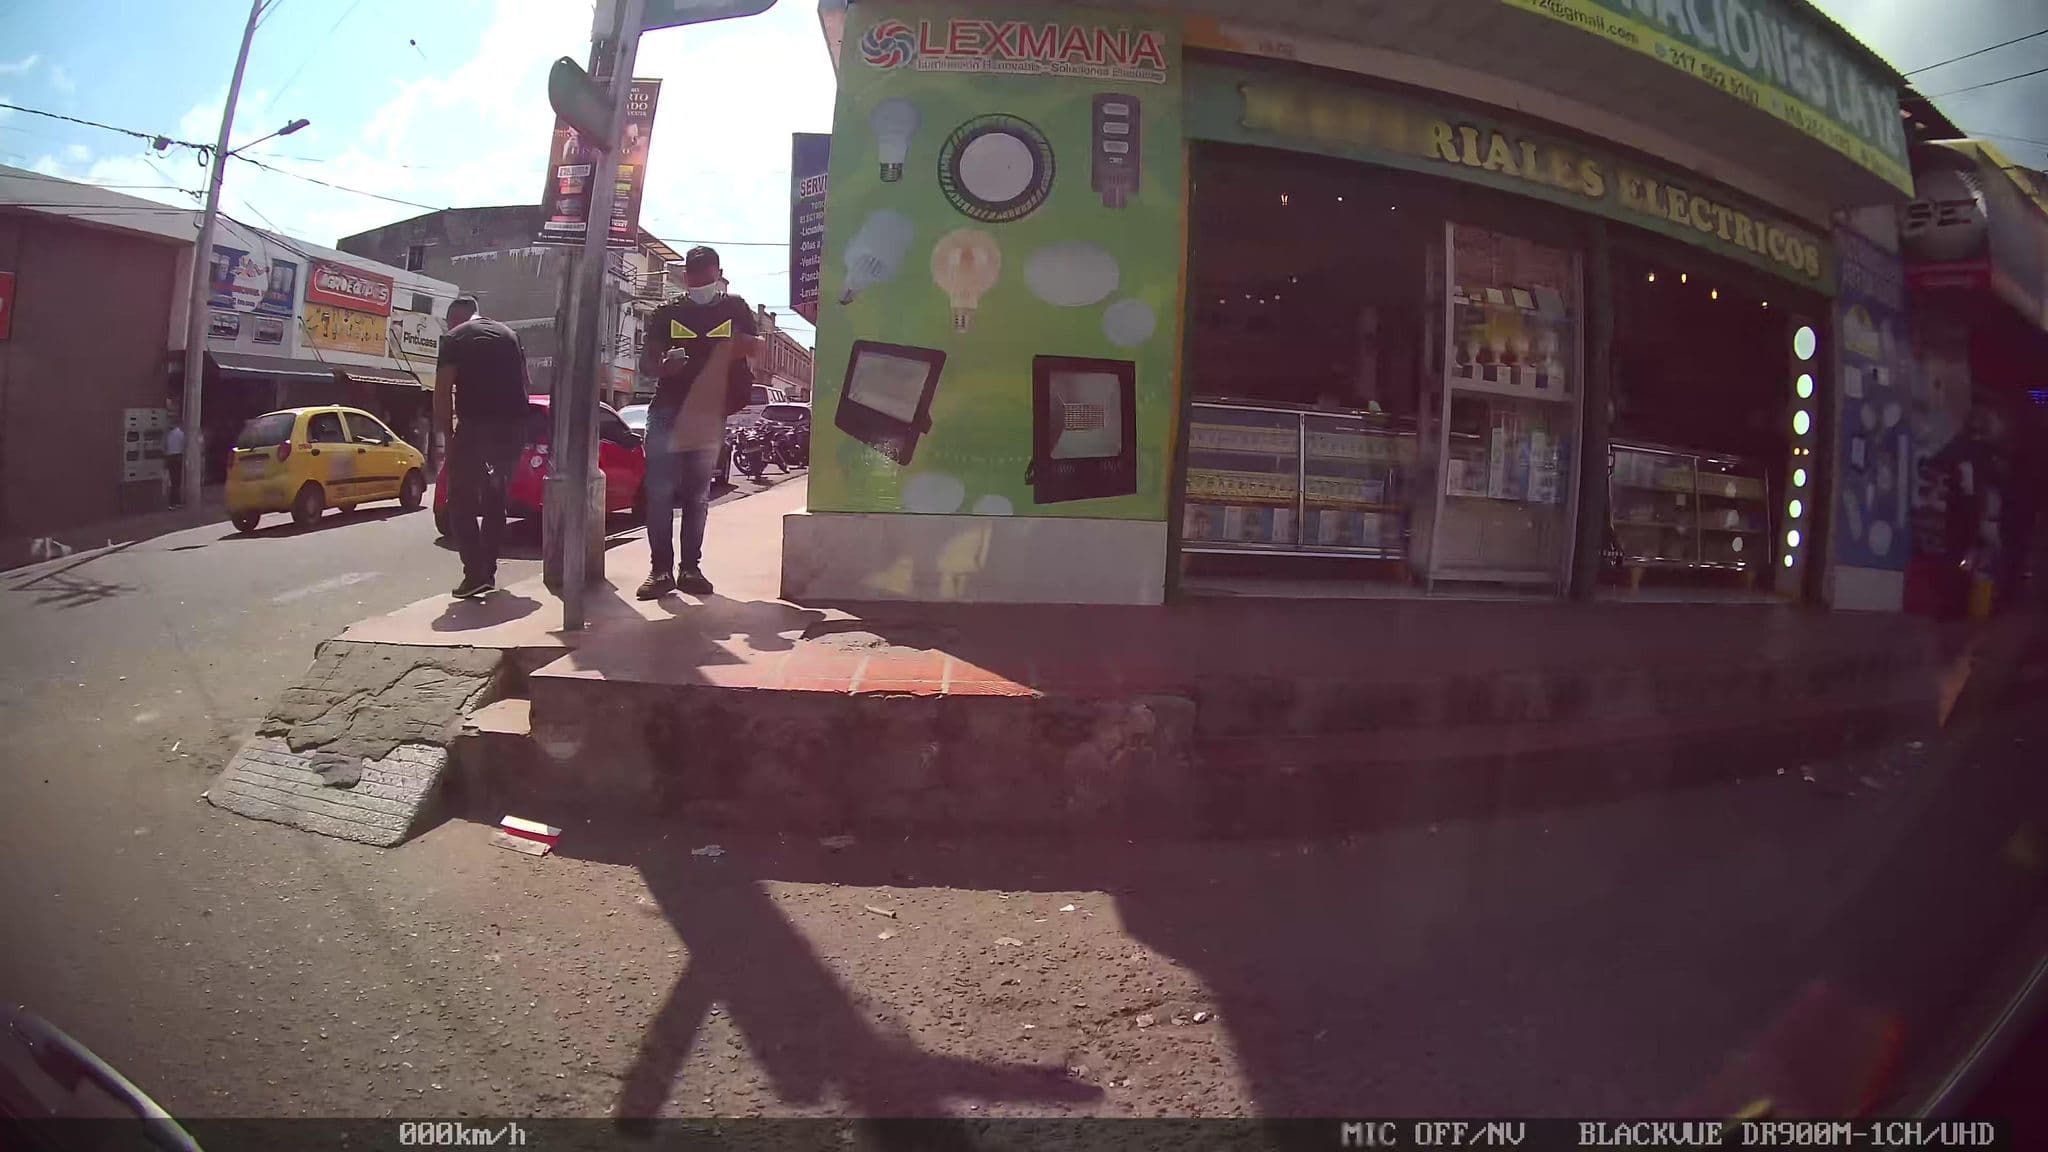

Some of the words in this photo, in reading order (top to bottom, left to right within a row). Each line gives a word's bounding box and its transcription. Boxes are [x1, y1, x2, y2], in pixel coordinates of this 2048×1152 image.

[918, 20, 1167, 69] LEXMANA
[1617, 170, 1820, 281] ELECTRICOS
[402, 330, 438, 349] Pintucasa
